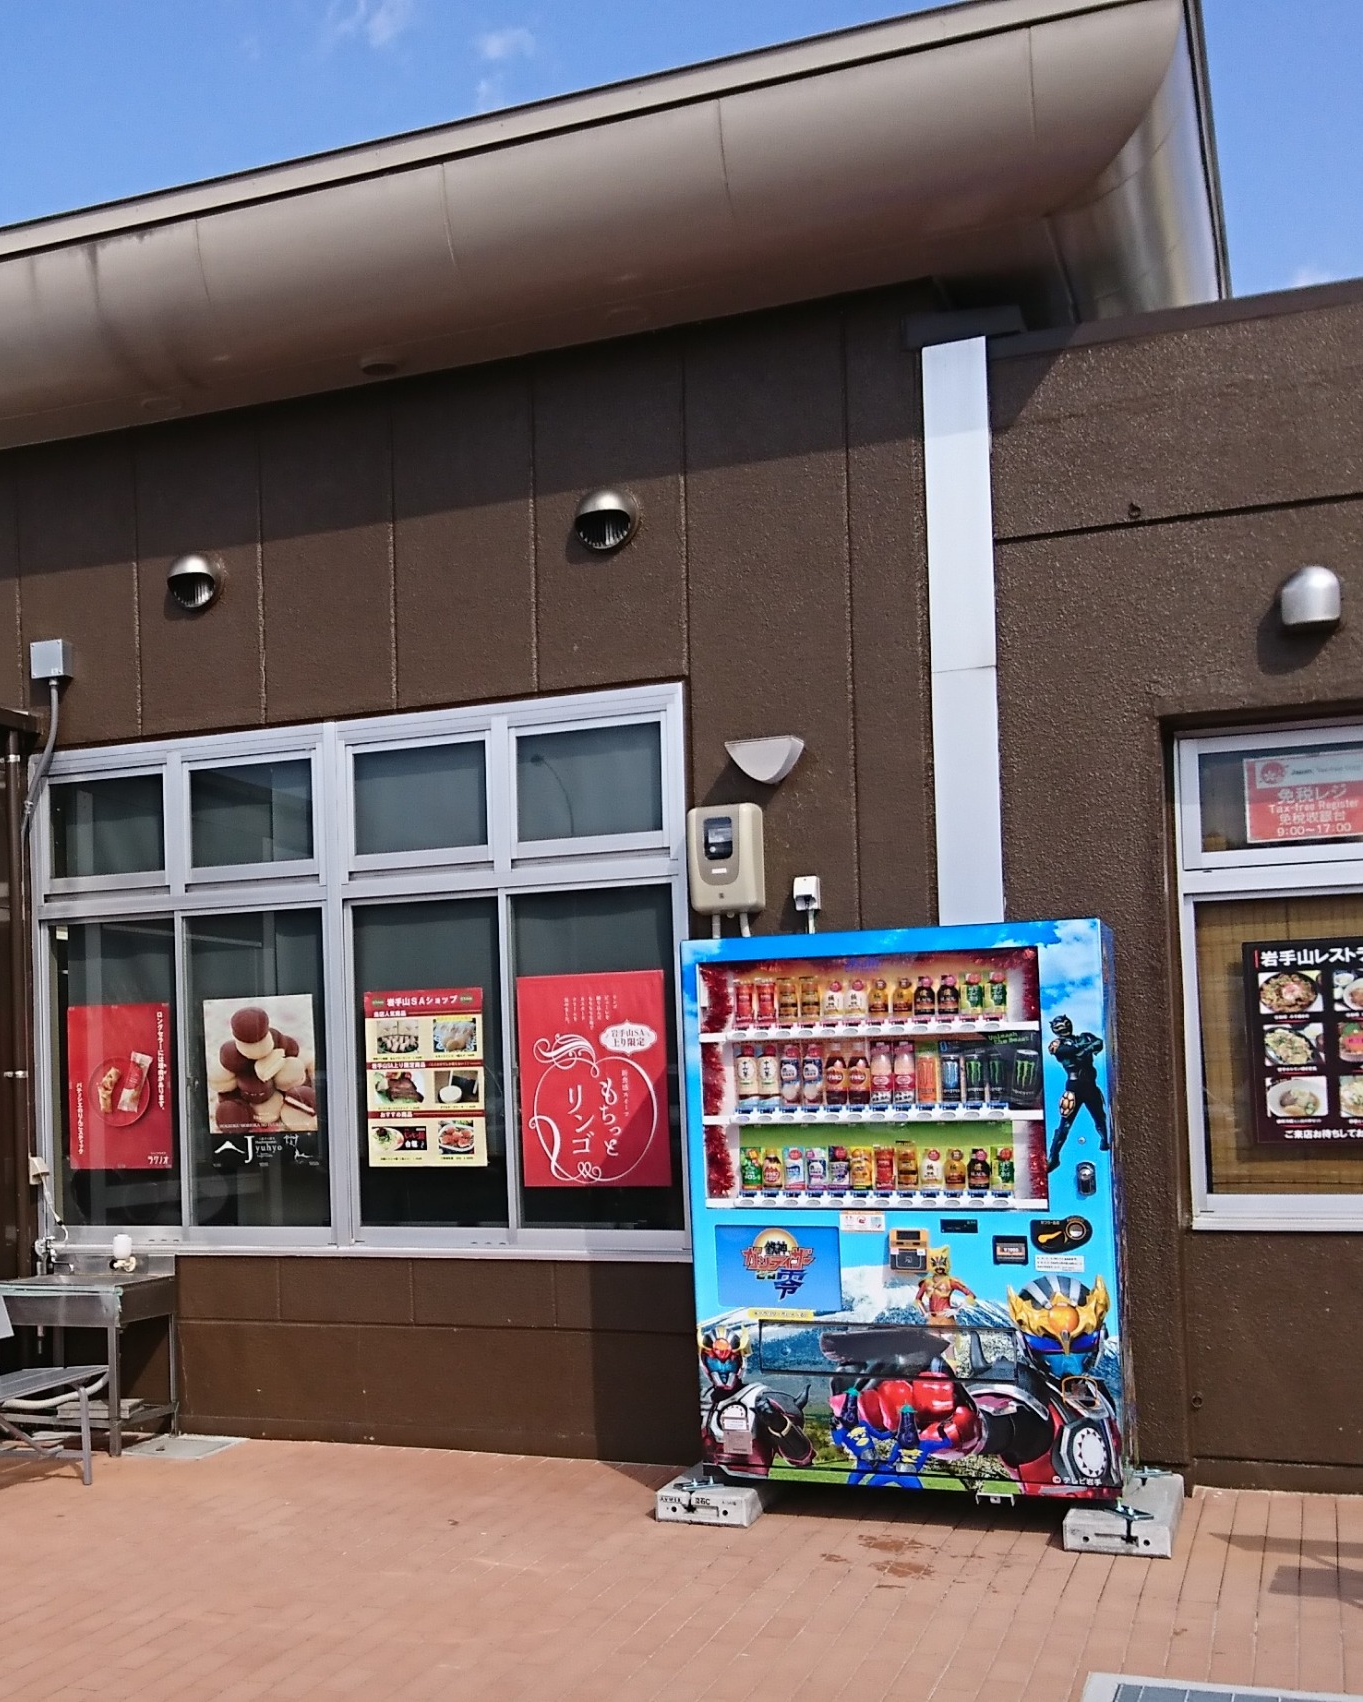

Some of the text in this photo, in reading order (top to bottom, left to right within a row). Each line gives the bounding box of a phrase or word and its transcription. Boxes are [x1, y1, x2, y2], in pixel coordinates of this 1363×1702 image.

[1277, 783, 1347, 804] 免税レジ
[1268, 799, 1359, 814] Tax-free Register
[612, 1037, 646, 1048] 上り限定
[568, 1084, 596, 1155] リンゴ
[599, 1077, 623, 1157] もちっと
[740, 1247, 816, 1271] ガンライザー
[1063, 1476, 1103, 1486] テレビ岩手
